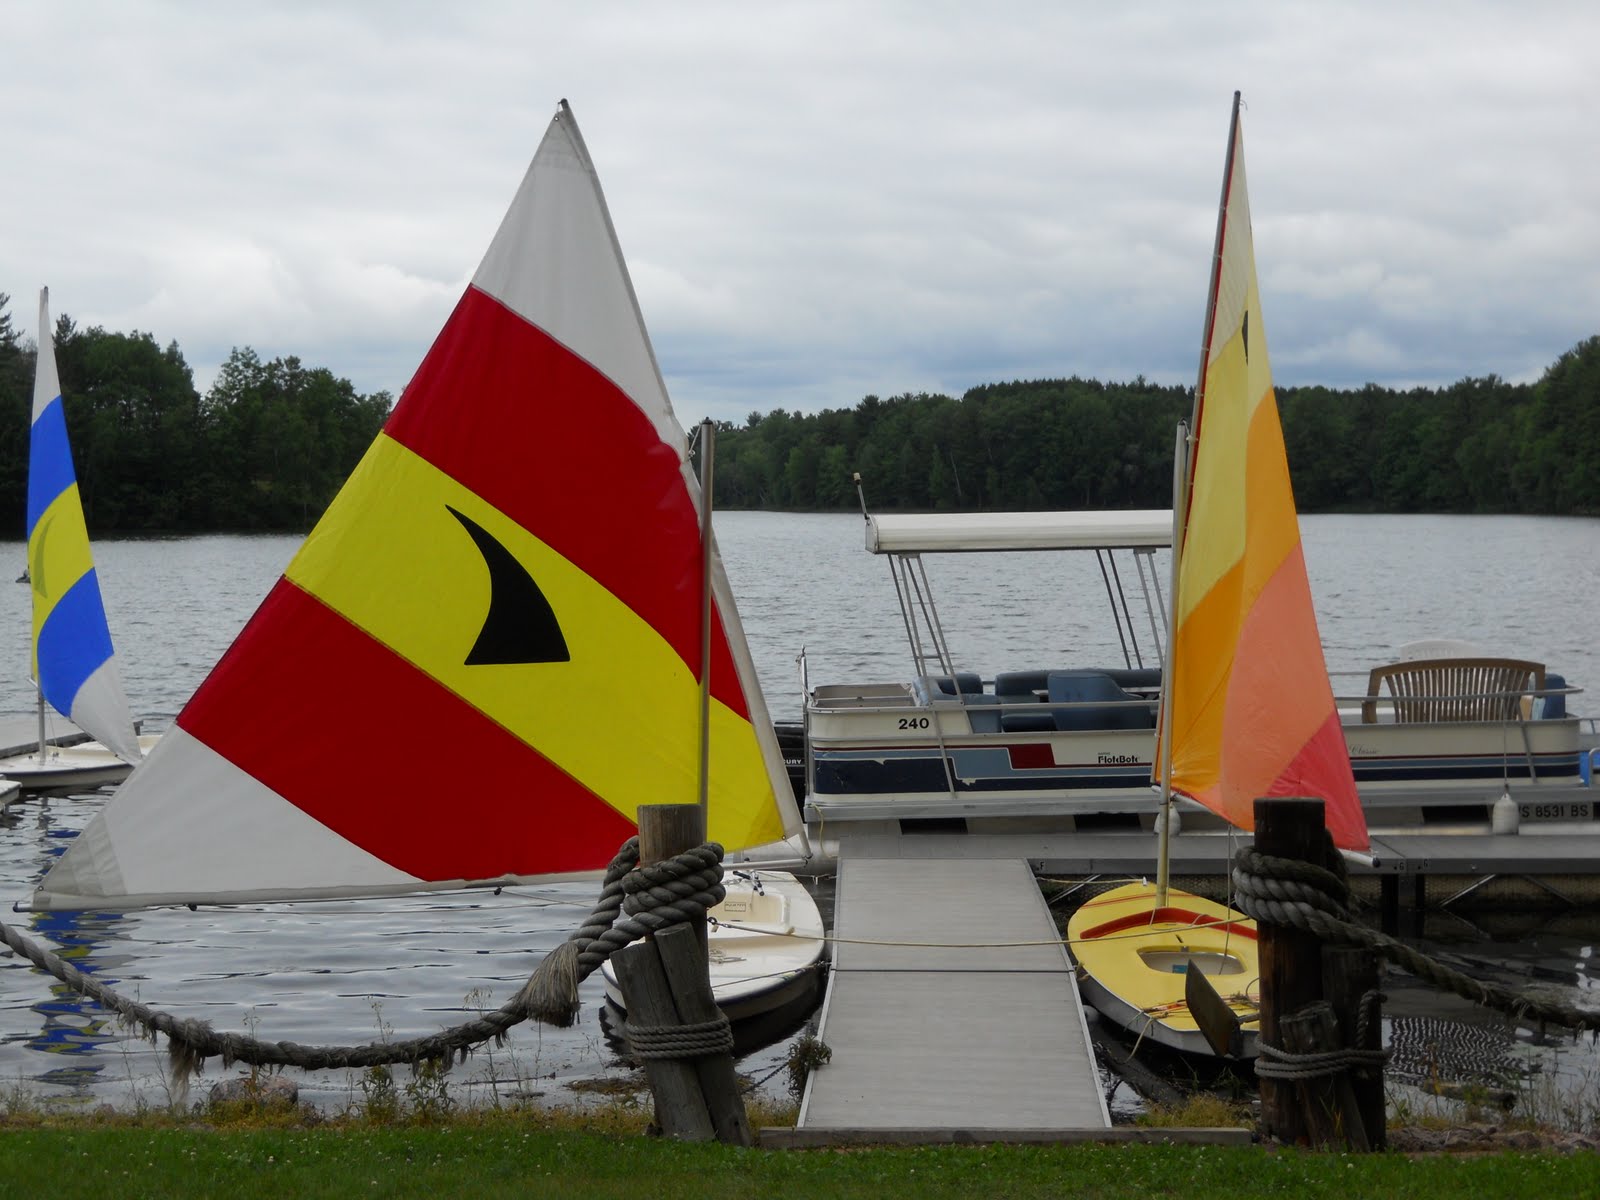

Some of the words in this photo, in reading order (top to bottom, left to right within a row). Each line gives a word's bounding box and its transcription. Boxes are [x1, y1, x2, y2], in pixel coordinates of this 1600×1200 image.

[898, 717, 930, 730] 240
[1519, 805, 1530, 818] S
[1535, 805, 1564, 818] 8531
[1570, 804, 1588, 817] BS
